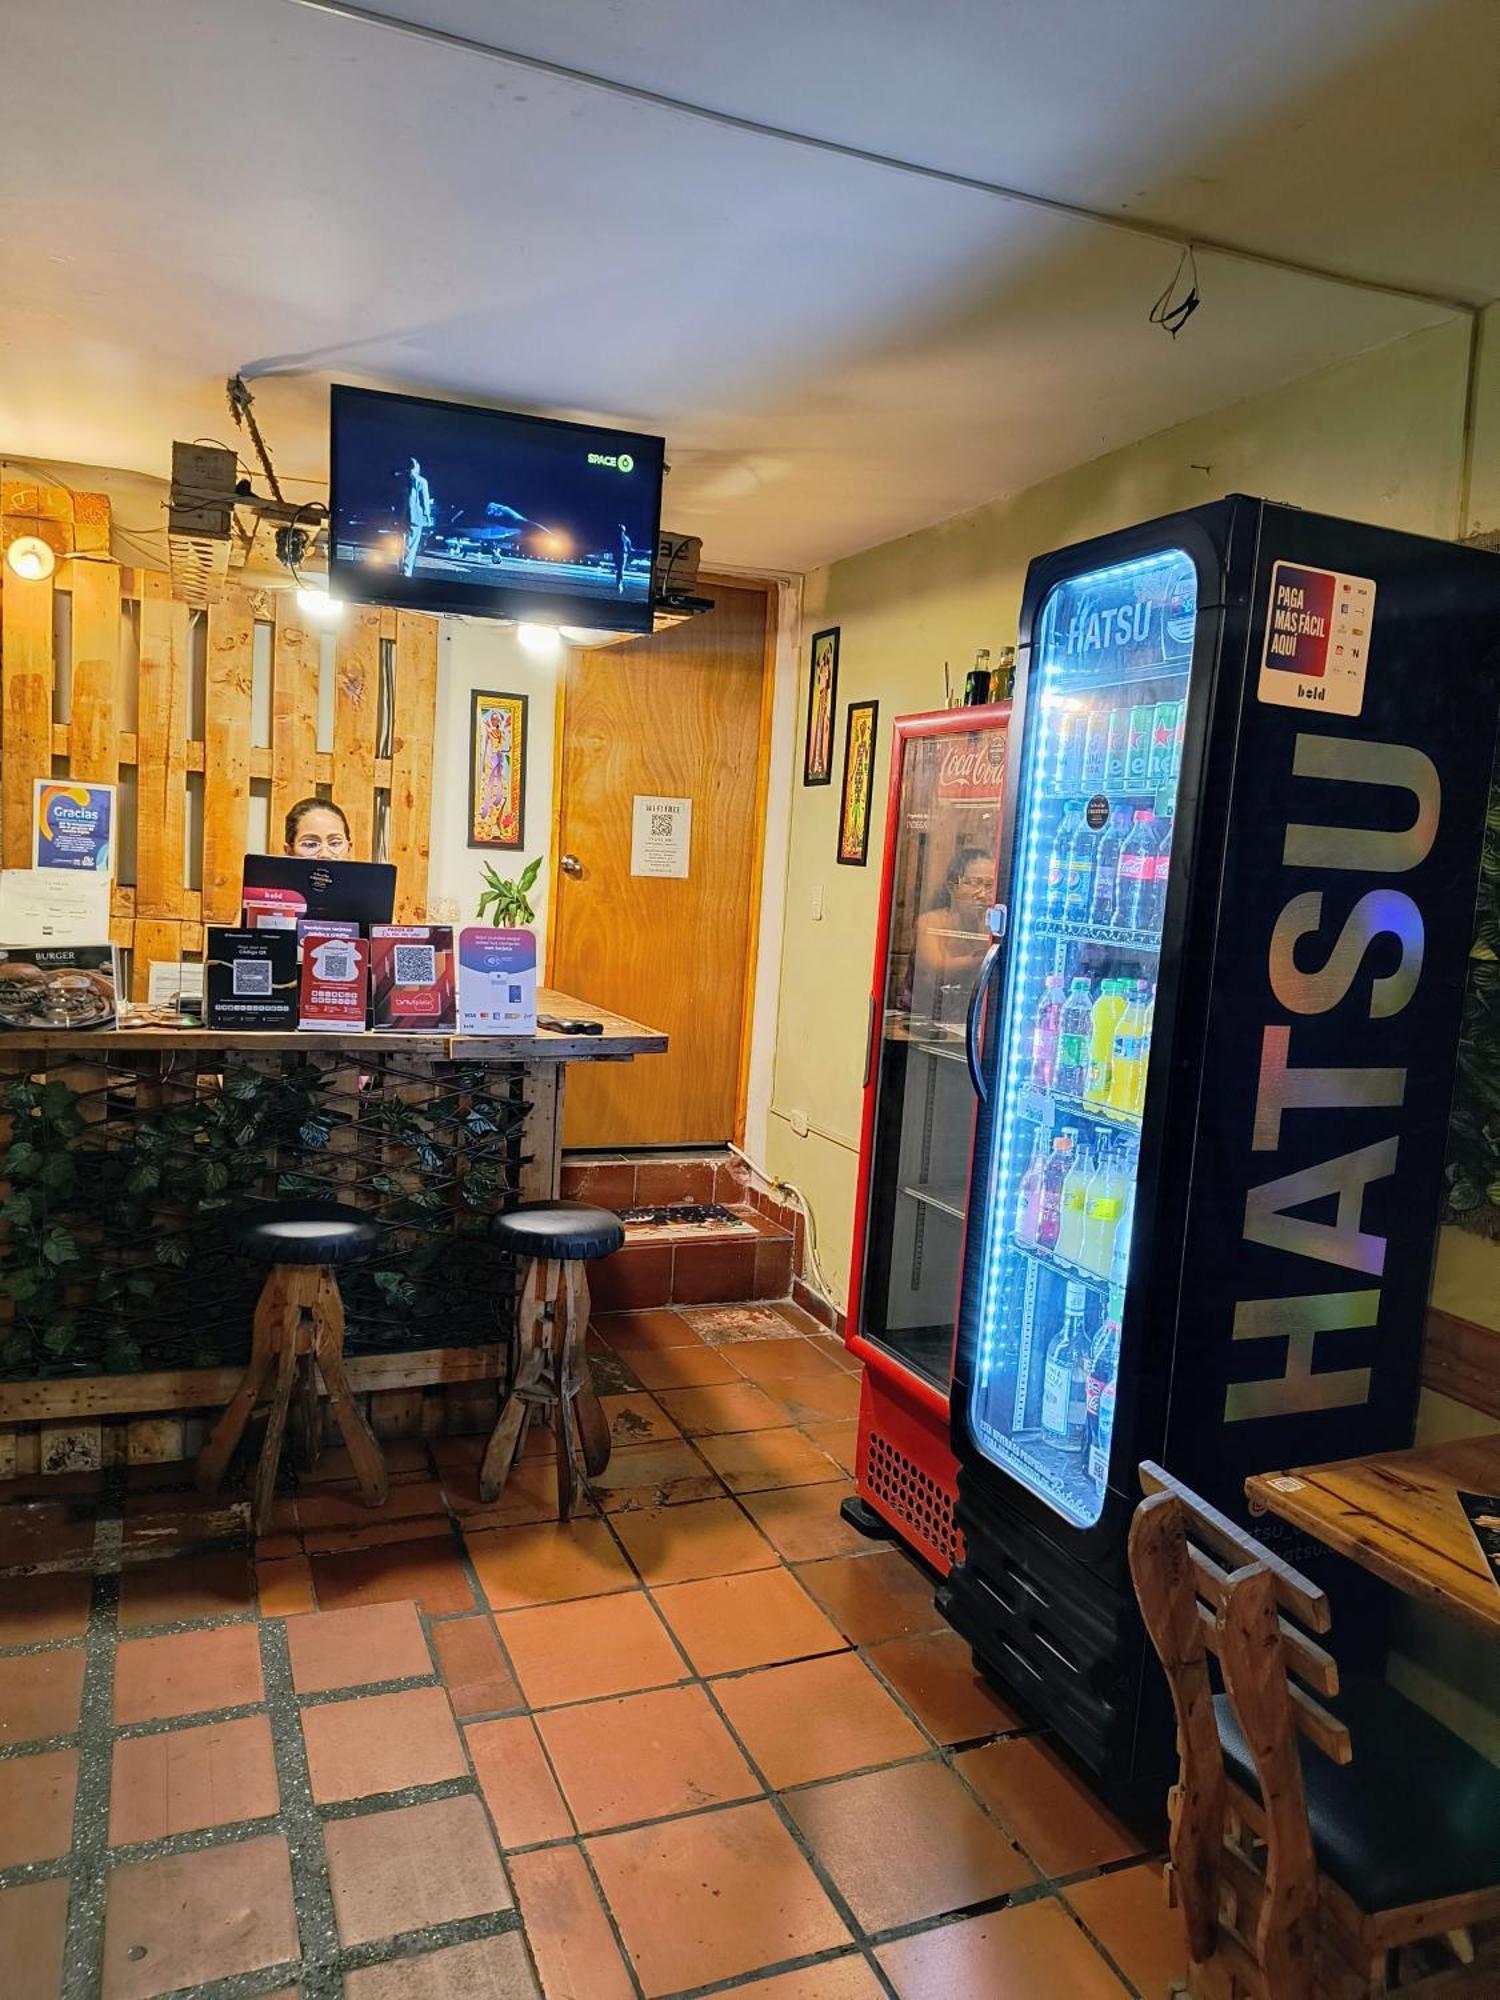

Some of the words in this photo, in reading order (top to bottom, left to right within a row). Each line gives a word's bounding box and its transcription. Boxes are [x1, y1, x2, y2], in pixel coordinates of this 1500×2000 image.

[588, 453, 617, 468] SPACE
[1277, 585, 1305, 610] PAGA
[1067, 600, 1153, 656] HATSU
[1274, 608, 1298, 633] MÁS
[1298, 611, 1326, 638] FÁCIL
[1271, 632, 1298, 657] AQUÍ
[1297, 684, 1326, 701] bold
[53, 806, 98, 820] Gracias
[35, 951, 75, 961] BURGER
[1223, 732, 1442, 1423] HATSU
